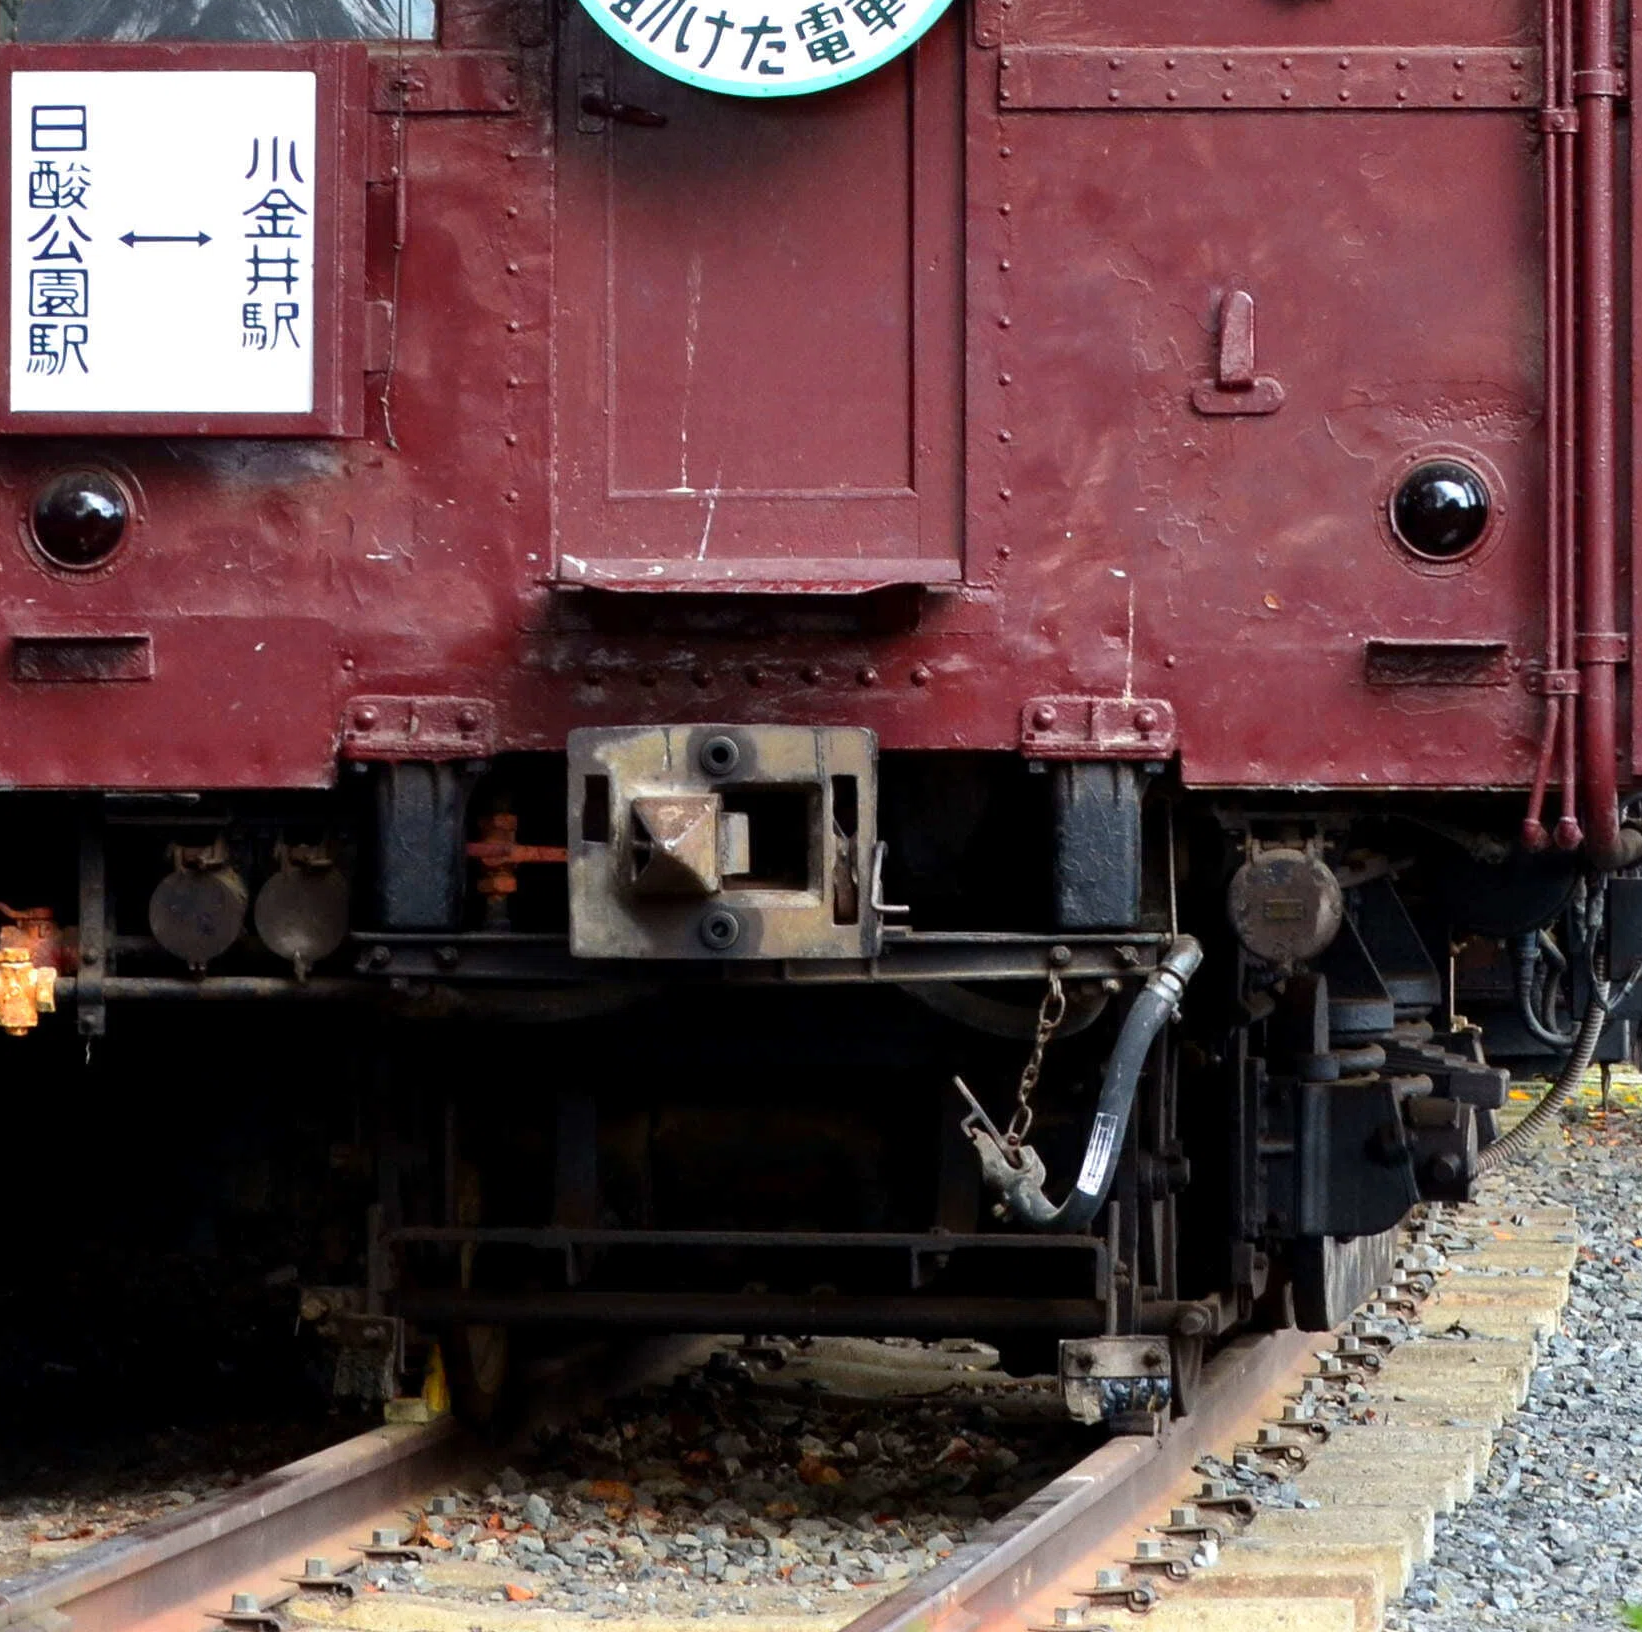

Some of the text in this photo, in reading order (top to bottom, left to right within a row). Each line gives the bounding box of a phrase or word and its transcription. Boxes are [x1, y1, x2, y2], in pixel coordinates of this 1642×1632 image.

[27, 105, 92, 376] 日酸公園駅
[242, 136, 308, 350] 小金井駅
